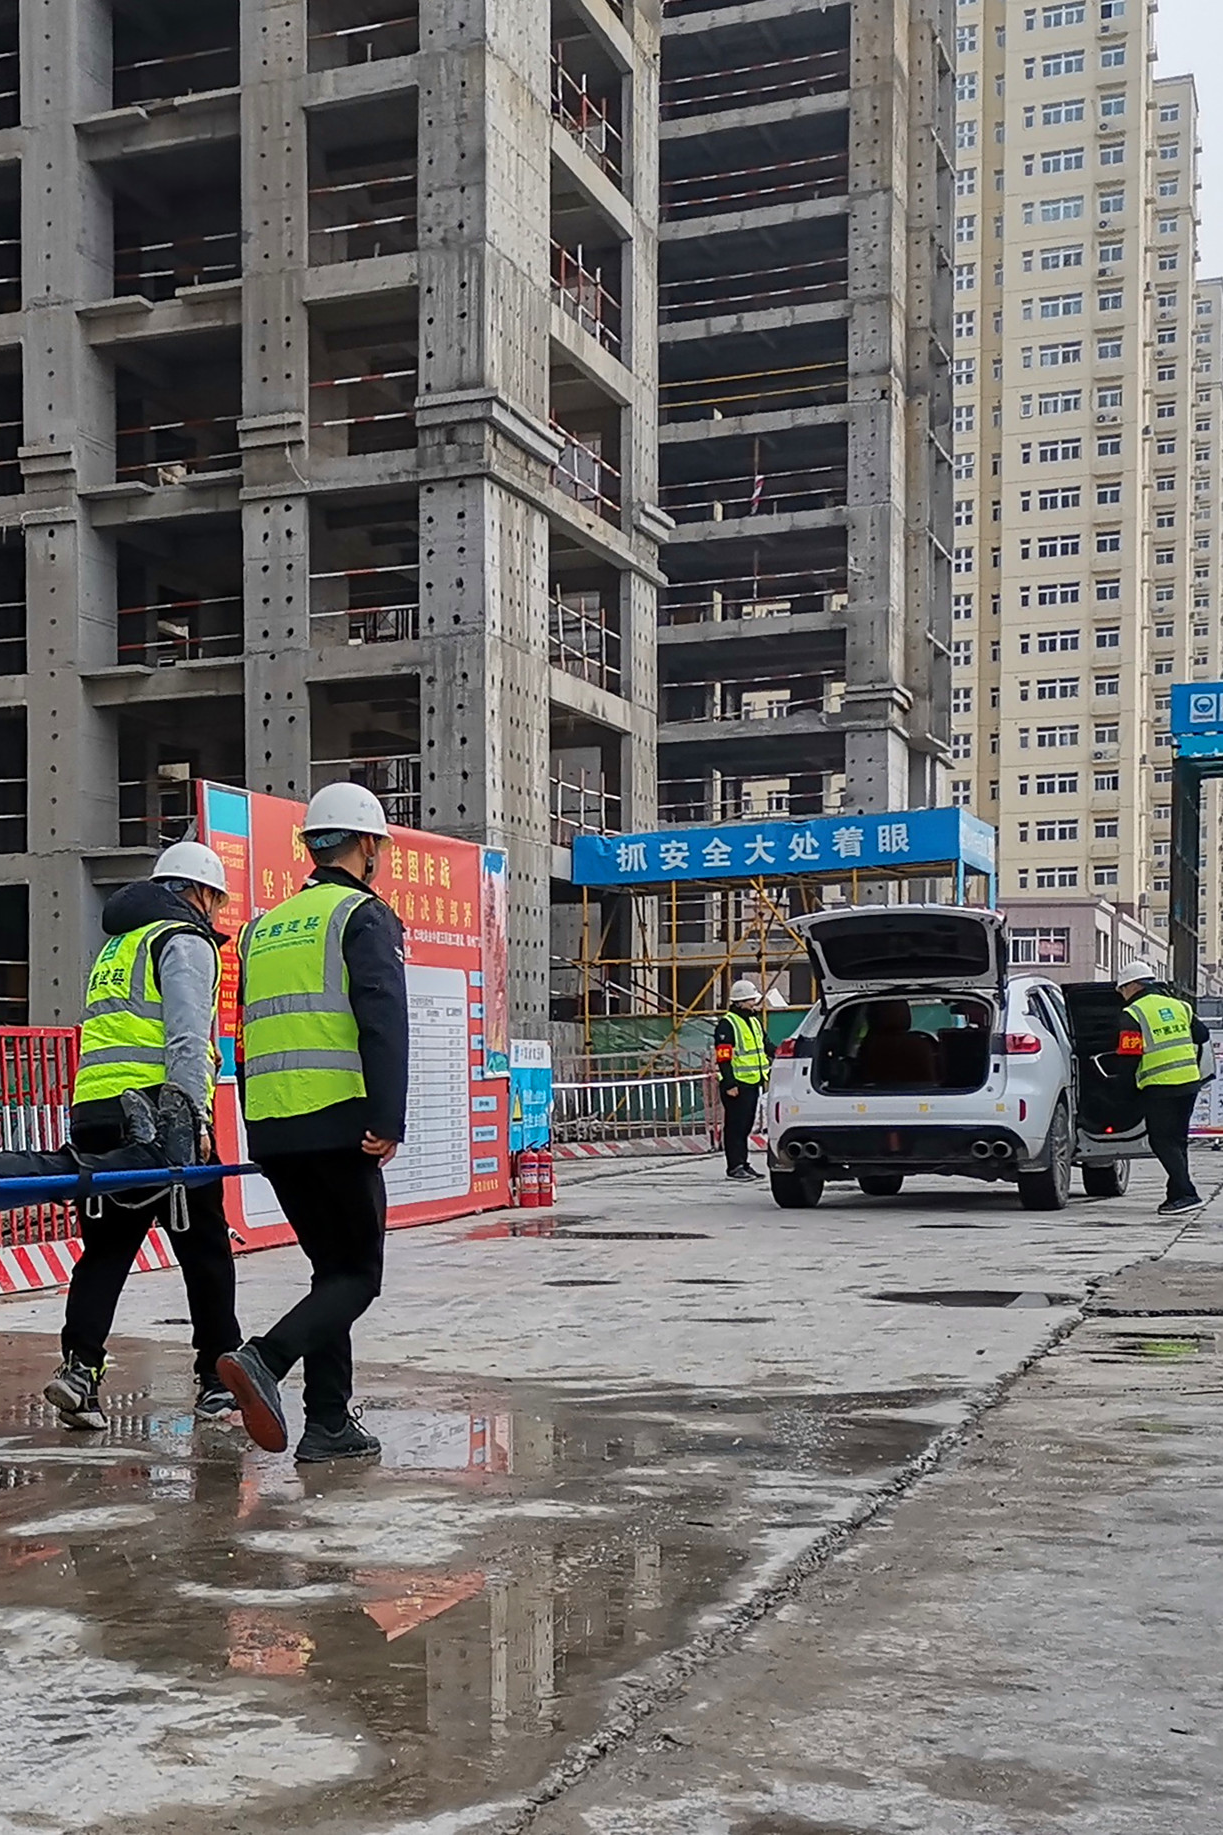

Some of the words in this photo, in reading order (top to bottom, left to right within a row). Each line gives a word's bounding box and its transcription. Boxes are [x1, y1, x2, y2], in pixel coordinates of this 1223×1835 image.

[615, 822, 911, 873] 抓安全大处着眼
